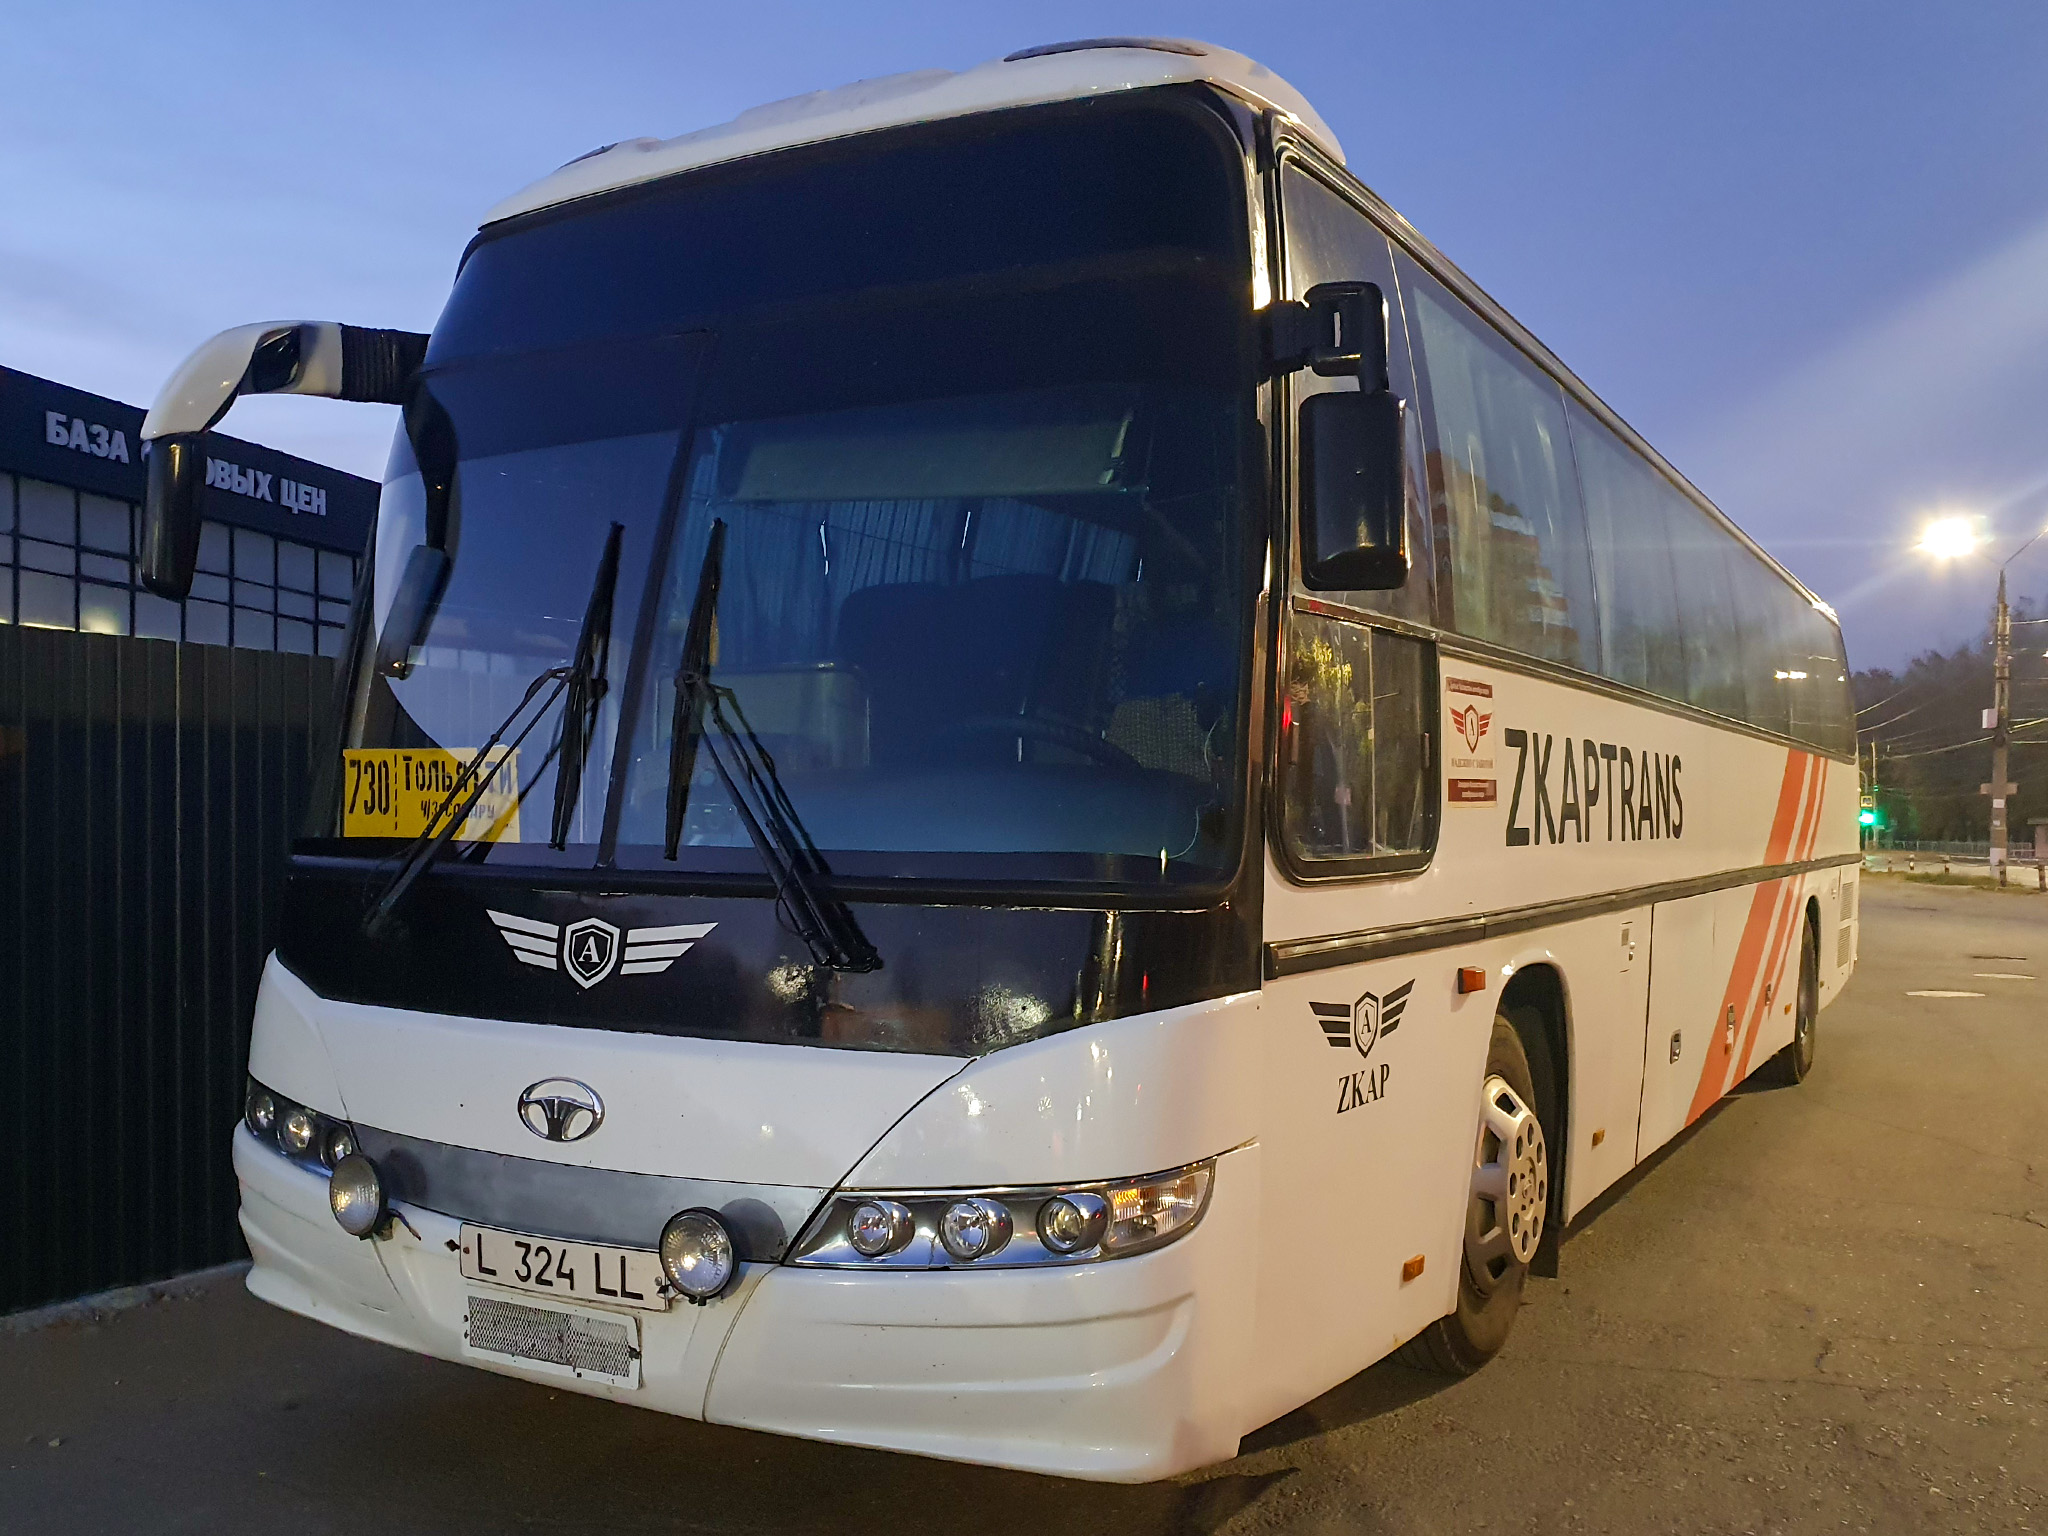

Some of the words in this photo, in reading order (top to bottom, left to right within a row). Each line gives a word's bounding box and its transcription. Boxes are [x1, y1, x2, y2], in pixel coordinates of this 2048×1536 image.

[45, 410, 130, 465] БАЗА
[279, 478, 327, 516] ЦЕН
[348, 758, 391, 815] 730
[1504, 727, 1683, 847] ZKAPTRANS
[577, 935, 601, 963] A
[1336, 1063, 1391, 1115] ZKAP
[476, 1232, 498, 1277] L
[514, 1240, 576, 1291] 324
[594, 1252, 644, 1301] LL
